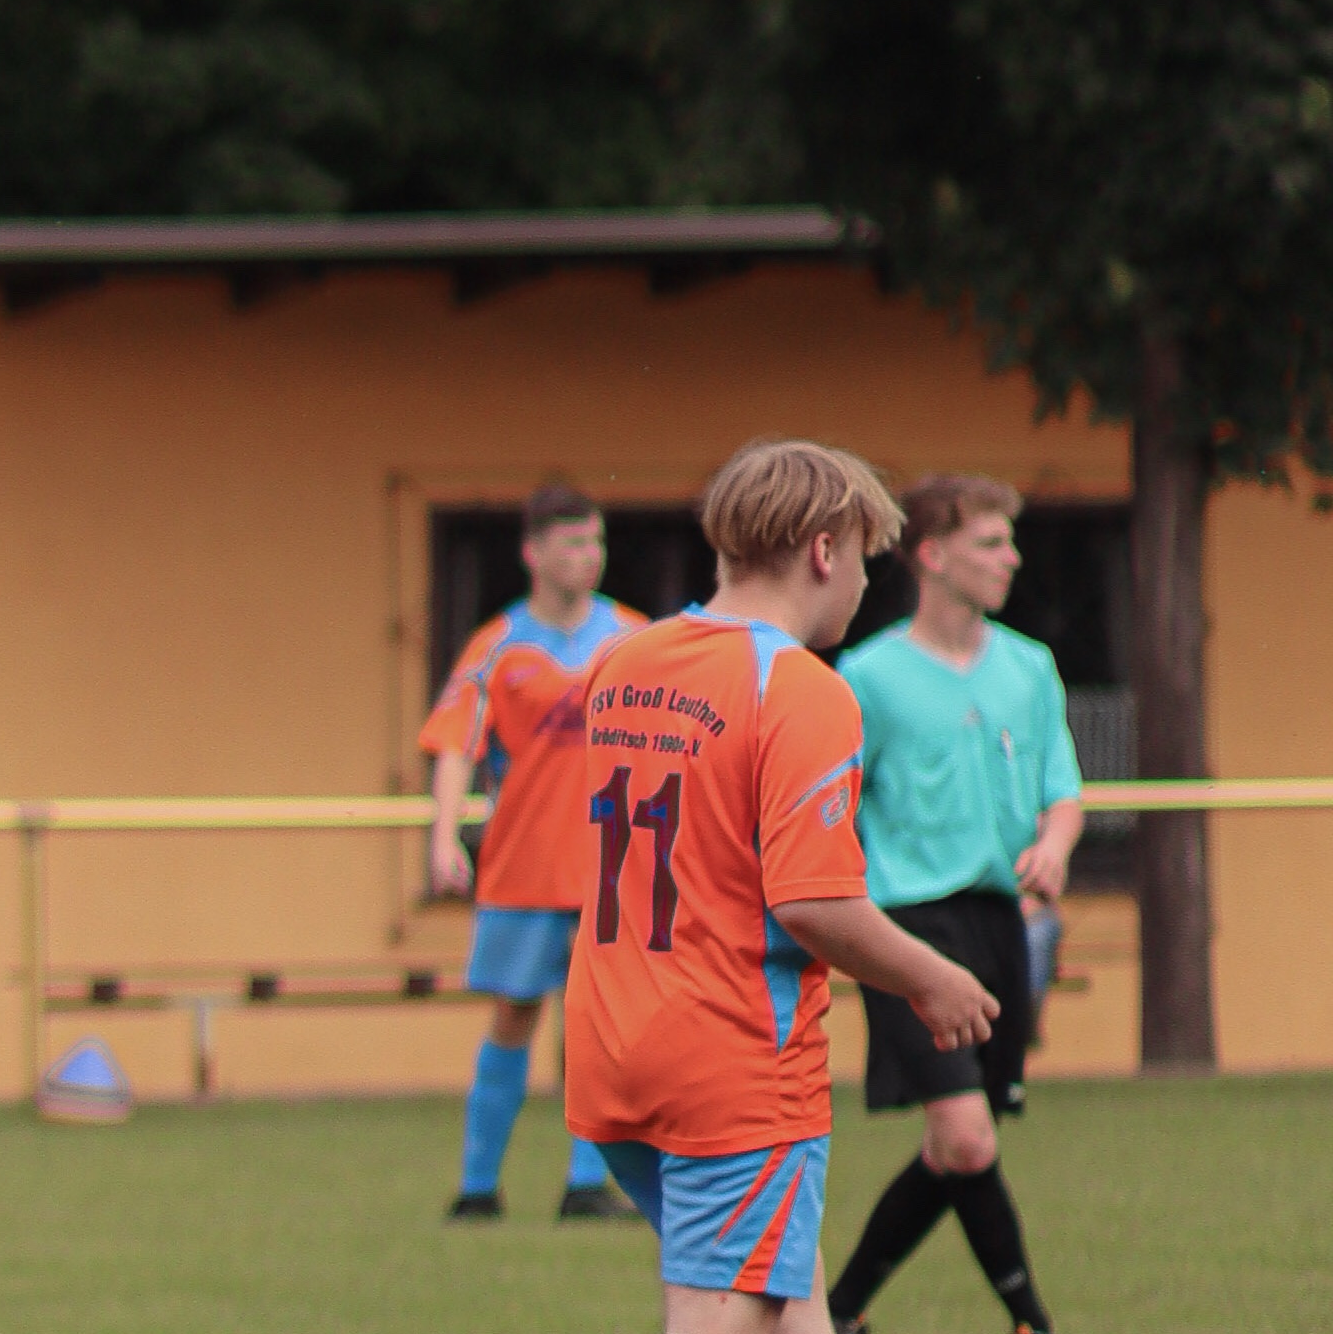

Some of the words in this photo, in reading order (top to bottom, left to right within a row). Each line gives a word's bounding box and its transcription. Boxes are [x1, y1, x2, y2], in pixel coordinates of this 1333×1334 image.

[622, 684, 664, 709] Groß
[668, 688, 726, 738] Leuthen
[589, 766, 681, 952] 11
